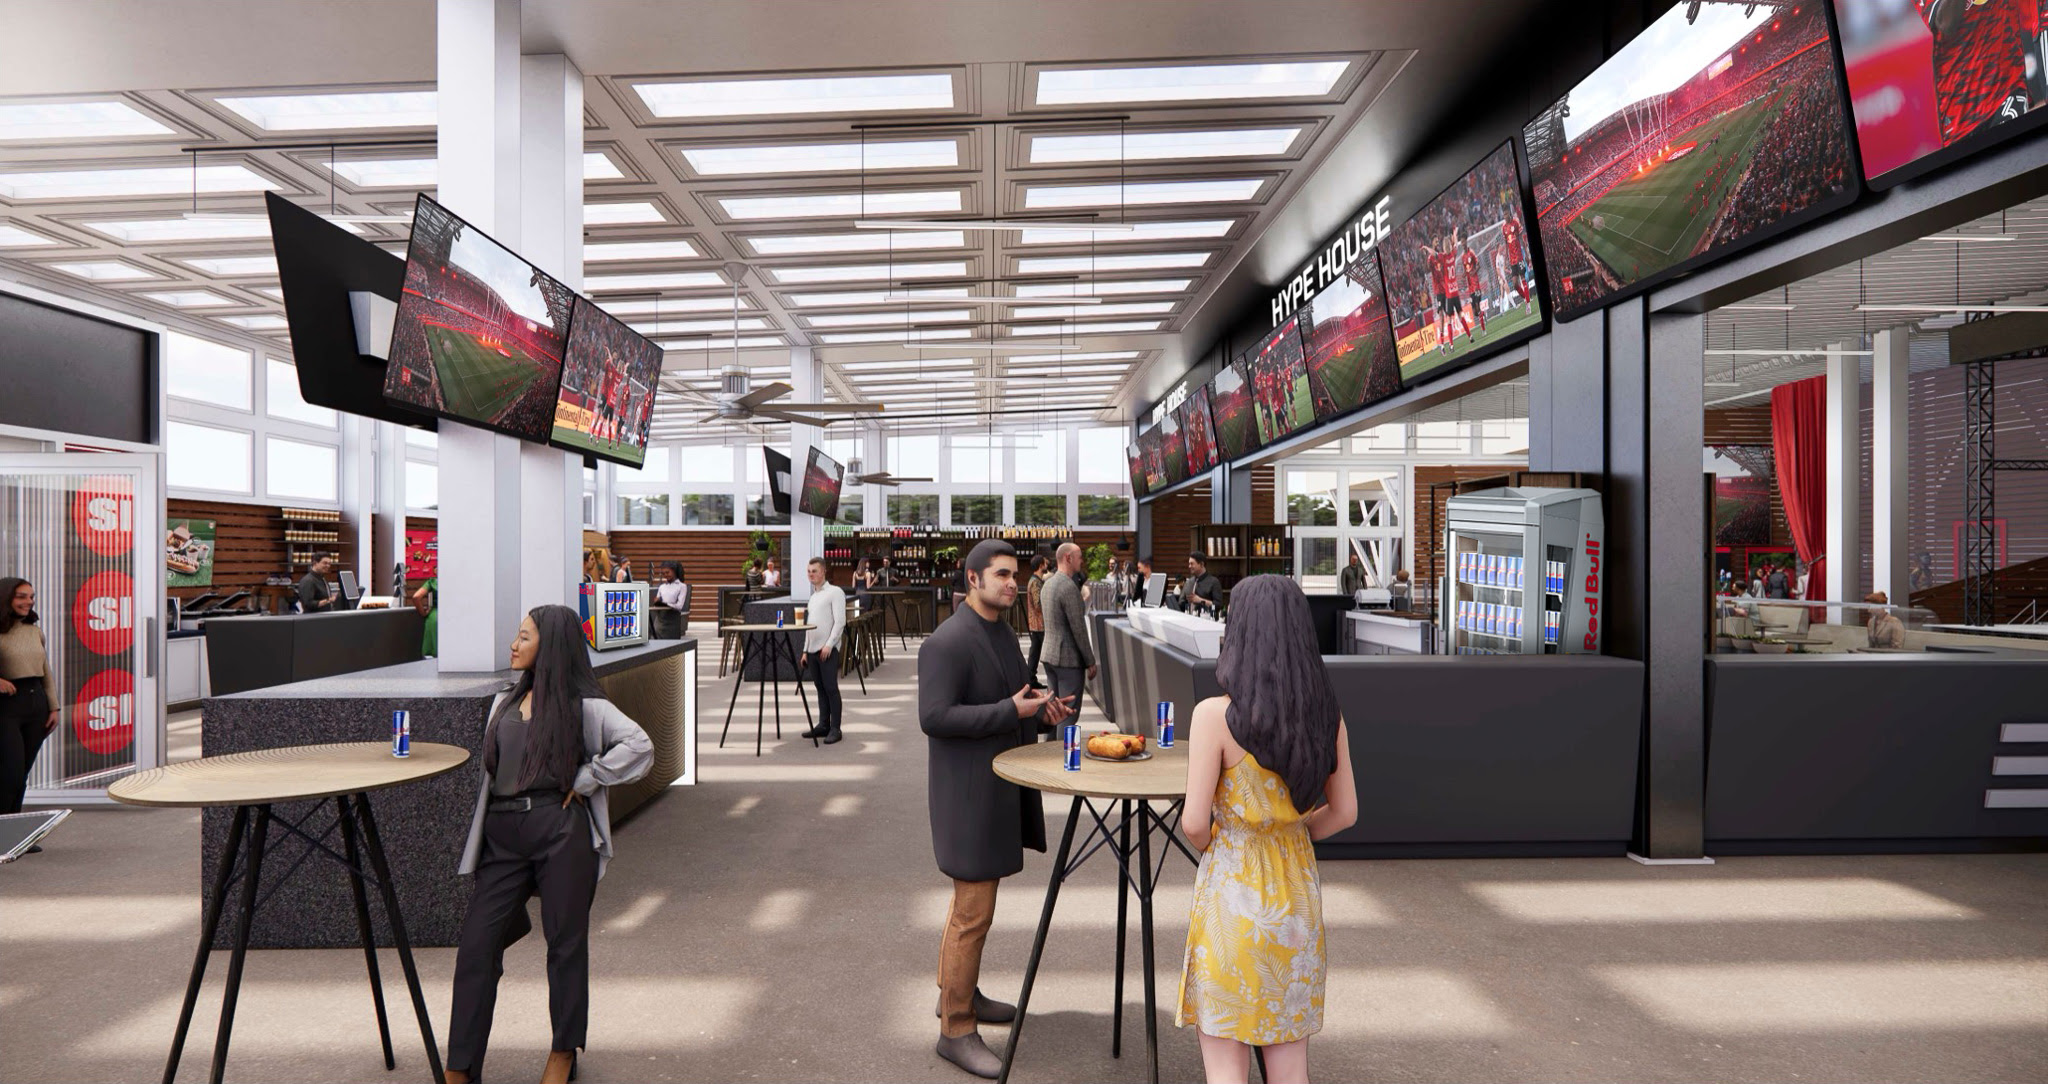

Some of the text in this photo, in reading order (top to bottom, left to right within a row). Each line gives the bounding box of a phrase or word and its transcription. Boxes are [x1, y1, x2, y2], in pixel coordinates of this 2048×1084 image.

[1271, 194, 1391, 327] HYPE HOUSE
[88, 497, 131, 532] SI
[88, 596, 132, 631] SI
[1584, 540, 1600, 650] Red Bull
[88, 692, 132, 731] SI
